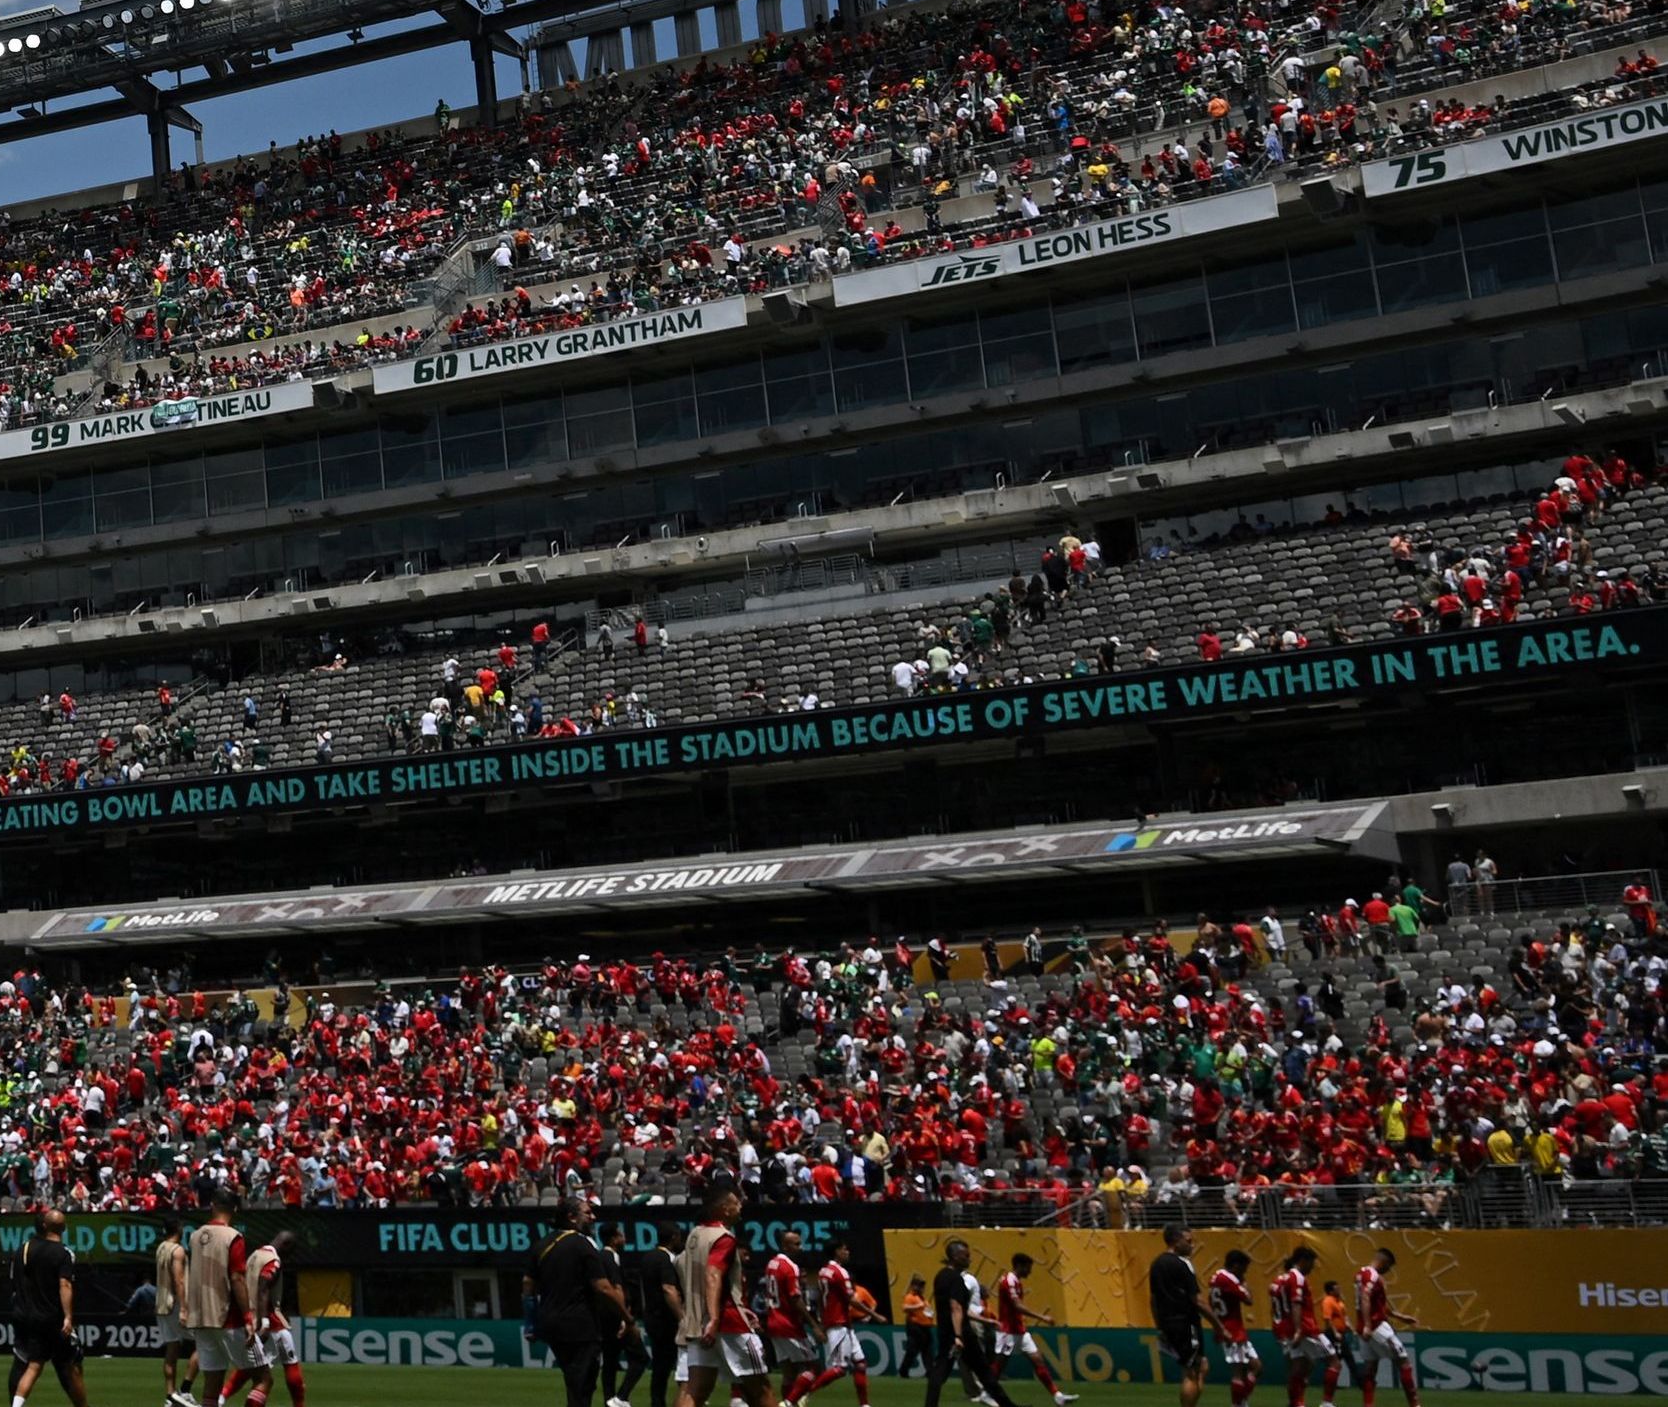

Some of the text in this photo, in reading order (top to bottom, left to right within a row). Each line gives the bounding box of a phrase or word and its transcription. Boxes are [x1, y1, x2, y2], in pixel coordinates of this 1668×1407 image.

[1389, 105, 1668, 188] 75 WINSTON
[921, 213, 1171, 286] JETS LEON HESS
[413, 309, 702, 384] 60 LARRY GRANTHAM
[31, 414, 144, 451] 99 MARK
[88, 792, 163, 822] BOWL
[171, 785, 237, 813] AREA
[247, 778, 306, 805] AND
[315, 769, 380, 799] TAKE
[391, 757, 501, 792] SHELTER
[512, 745, 606, 780] INSIDE
[616, 738, 669, 768] THE
[680, 722, 820, 762] STADIUM
[831, 703, 973, 746] BECAUSE
[984, 697, 1029, 729] OF
[1043, 680, 1167, 723] SEVERE
[1178, 658, 1357, 706] WEATHER
[1371, 650, 1416, 683] IN
[1427, 640, 1501, 677] THE
[1518, 625, 1640, 667] AREA.
[1163, 821, 1302, 844] MetLife
[483, 863, 783, 904] METLIFE STADIUM
[124, 909, 221, 927] MetLife
[101, 1226, 156, 1251] CUP
[378, 1223, 531, 1252] FIFA CLUB
[105, 1325, 164, 1349] 2025
[1033, 1330, 1164, 1384] No. 1
